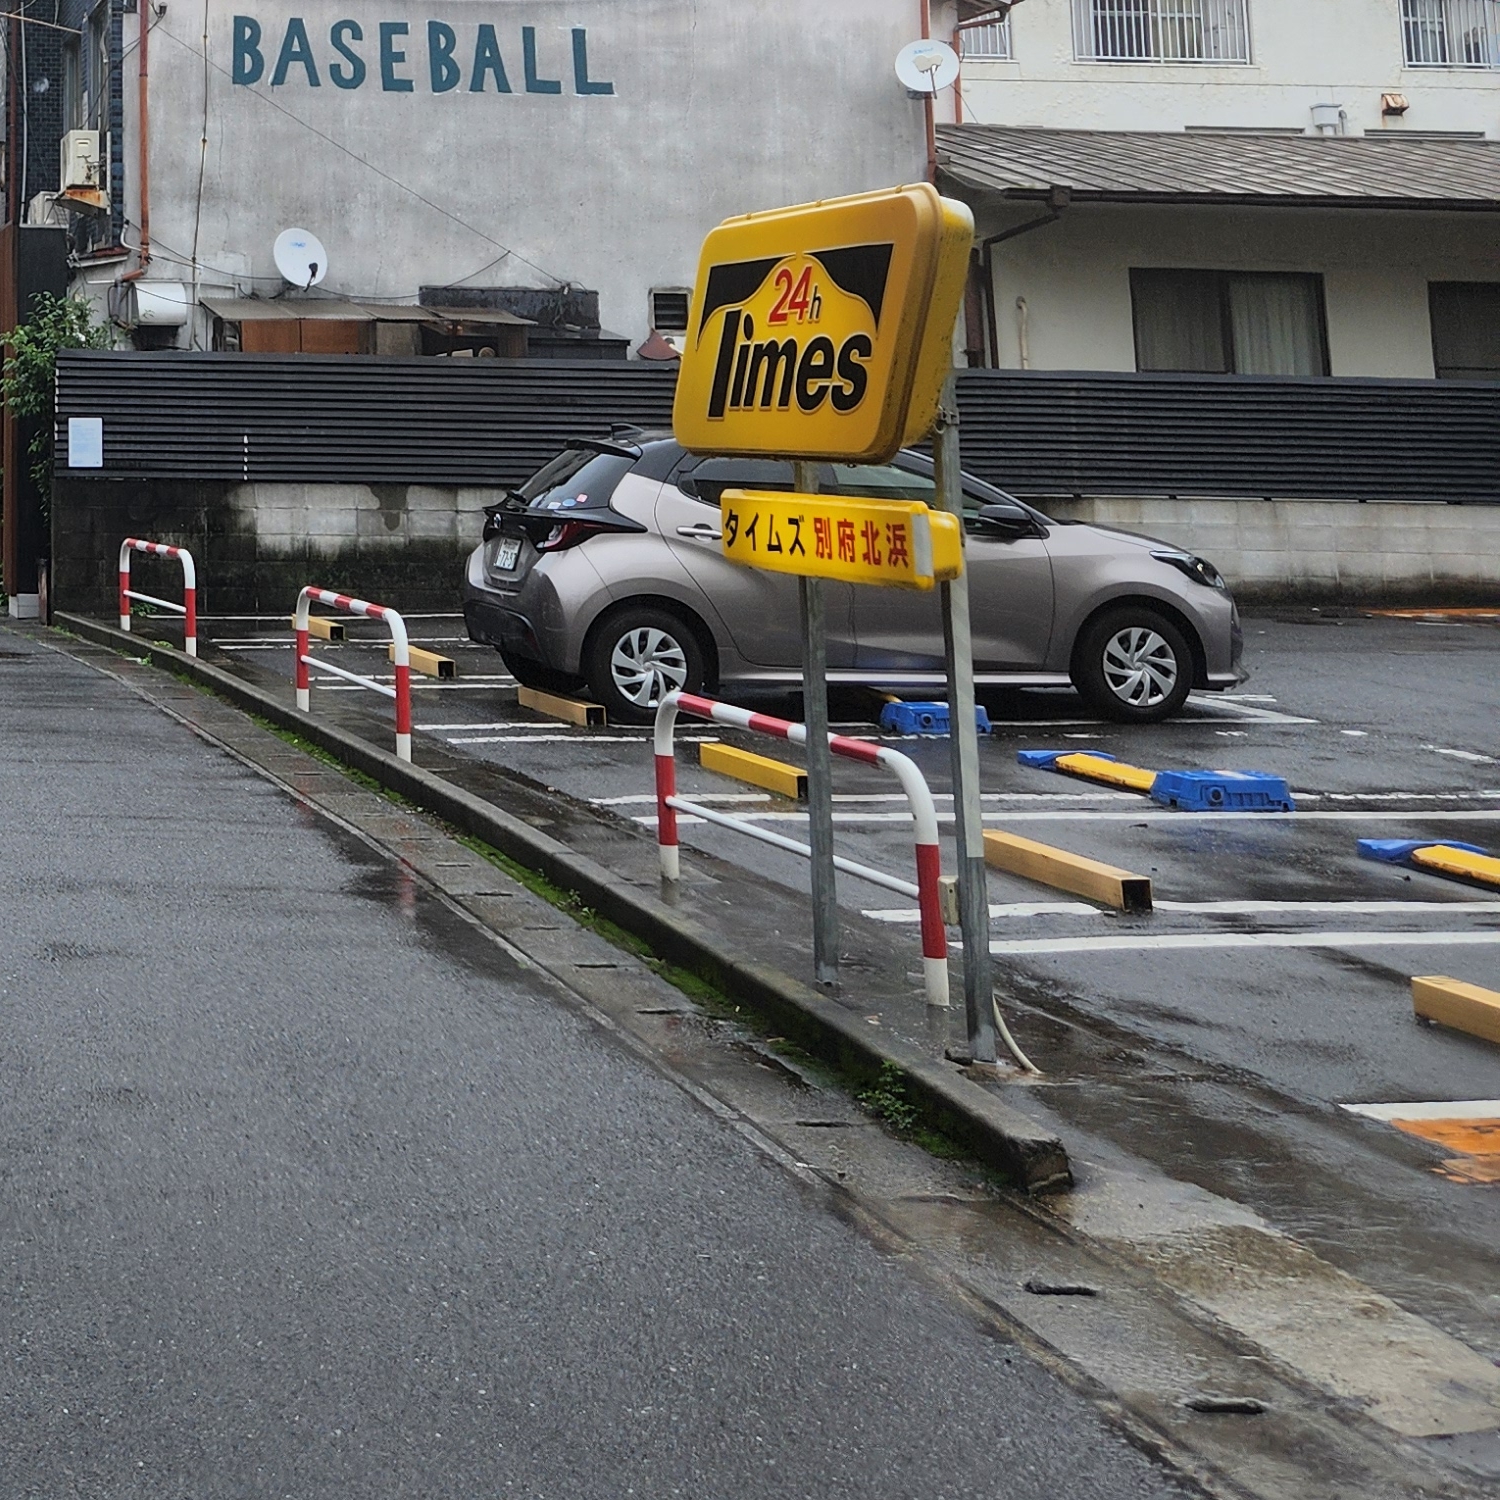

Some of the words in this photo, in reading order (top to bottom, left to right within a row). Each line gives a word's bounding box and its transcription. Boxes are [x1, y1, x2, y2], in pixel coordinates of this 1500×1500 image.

[232, 15, 615, 95] BASEBALL
[768, 256, 823, 323] 24h
[724, 508, 909, 569] タイムズ別府北浜
